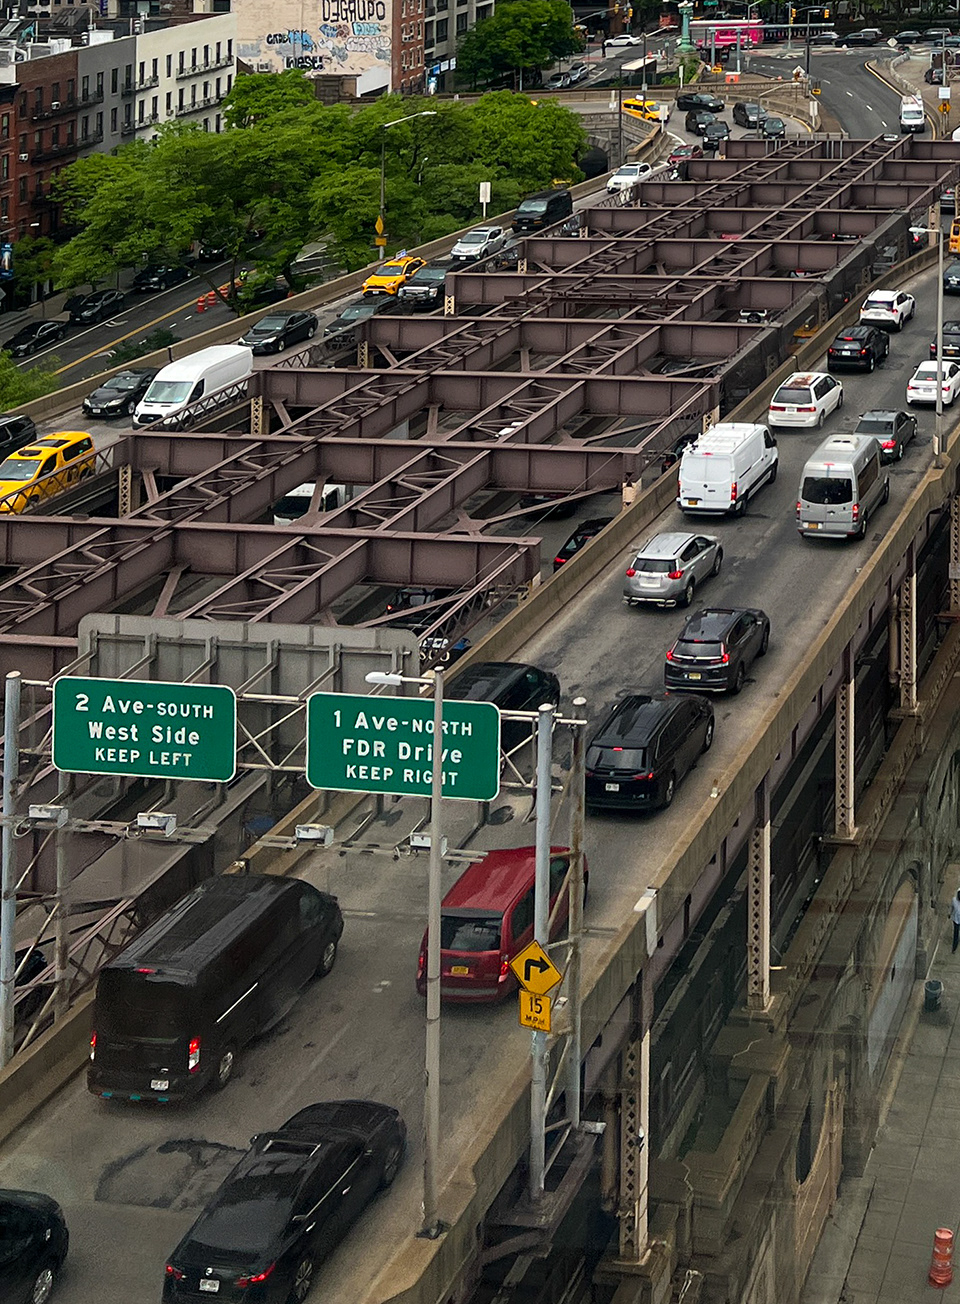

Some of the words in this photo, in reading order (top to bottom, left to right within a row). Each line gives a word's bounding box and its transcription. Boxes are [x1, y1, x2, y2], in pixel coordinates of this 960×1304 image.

[75, 693, 90, 712] 2
[333, 709, 341, 727] 1
[88, 721, 139, 742] West
[151, 725, 200, 746] Side
[95, 747, 141, 763] KEEP
[149, 750, 192, 767] LEFT
[342, 738, 386, 758] FDR
[346, 764, 394, 781] KEEP
[529, 996, 543, 1015] 15
[524, 1014, 546, 1026] MPH
